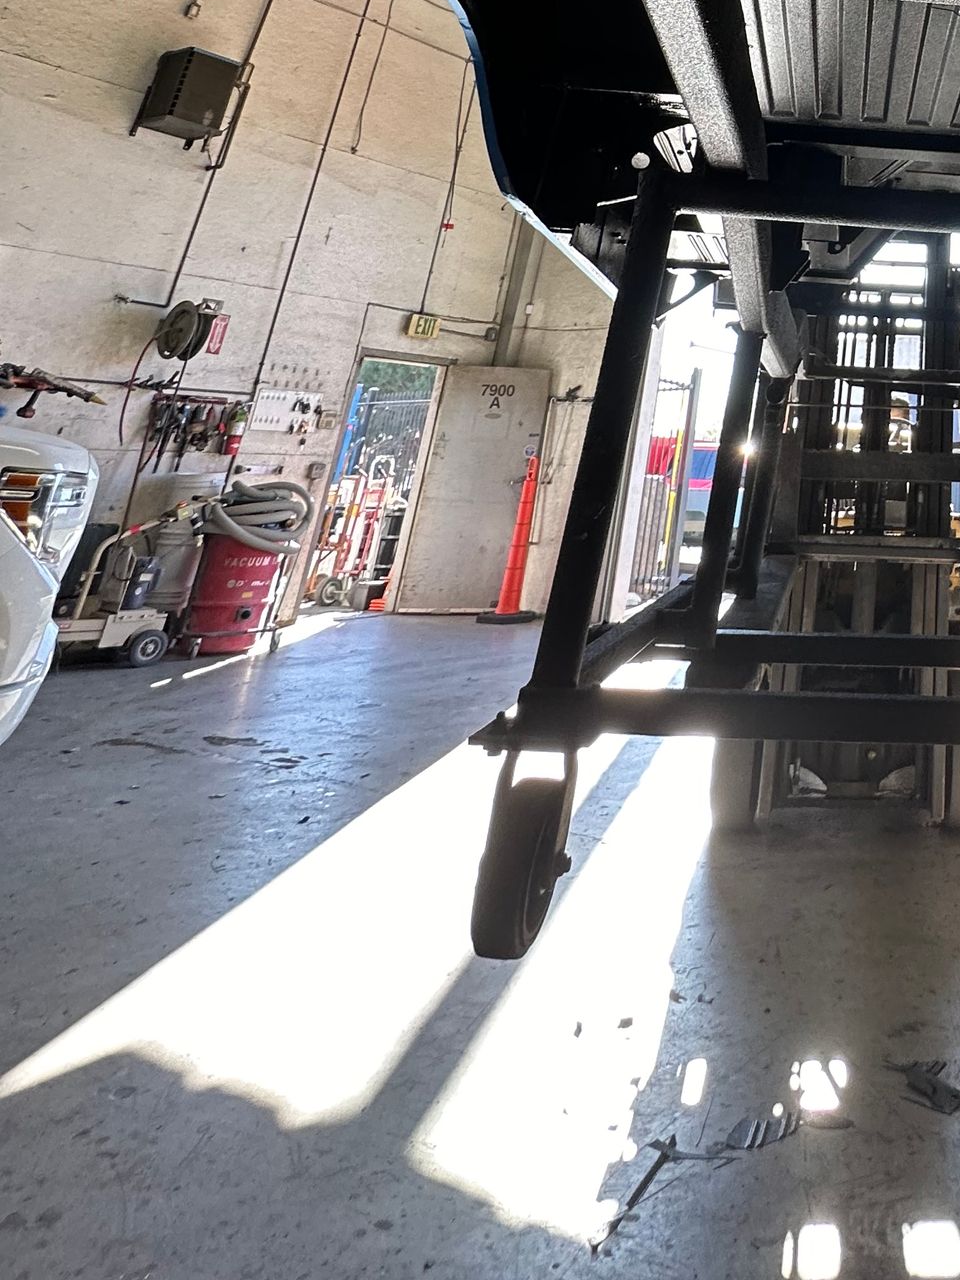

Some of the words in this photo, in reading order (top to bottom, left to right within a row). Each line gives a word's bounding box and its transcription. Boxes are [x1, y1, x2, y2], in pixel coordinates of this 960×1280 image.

[415, 316, 437, 336] EXIT
[481, 384, 515, 397] 7900
[489, 396, 500, 409] A
[225, 556, 271, 567] VACUUM
